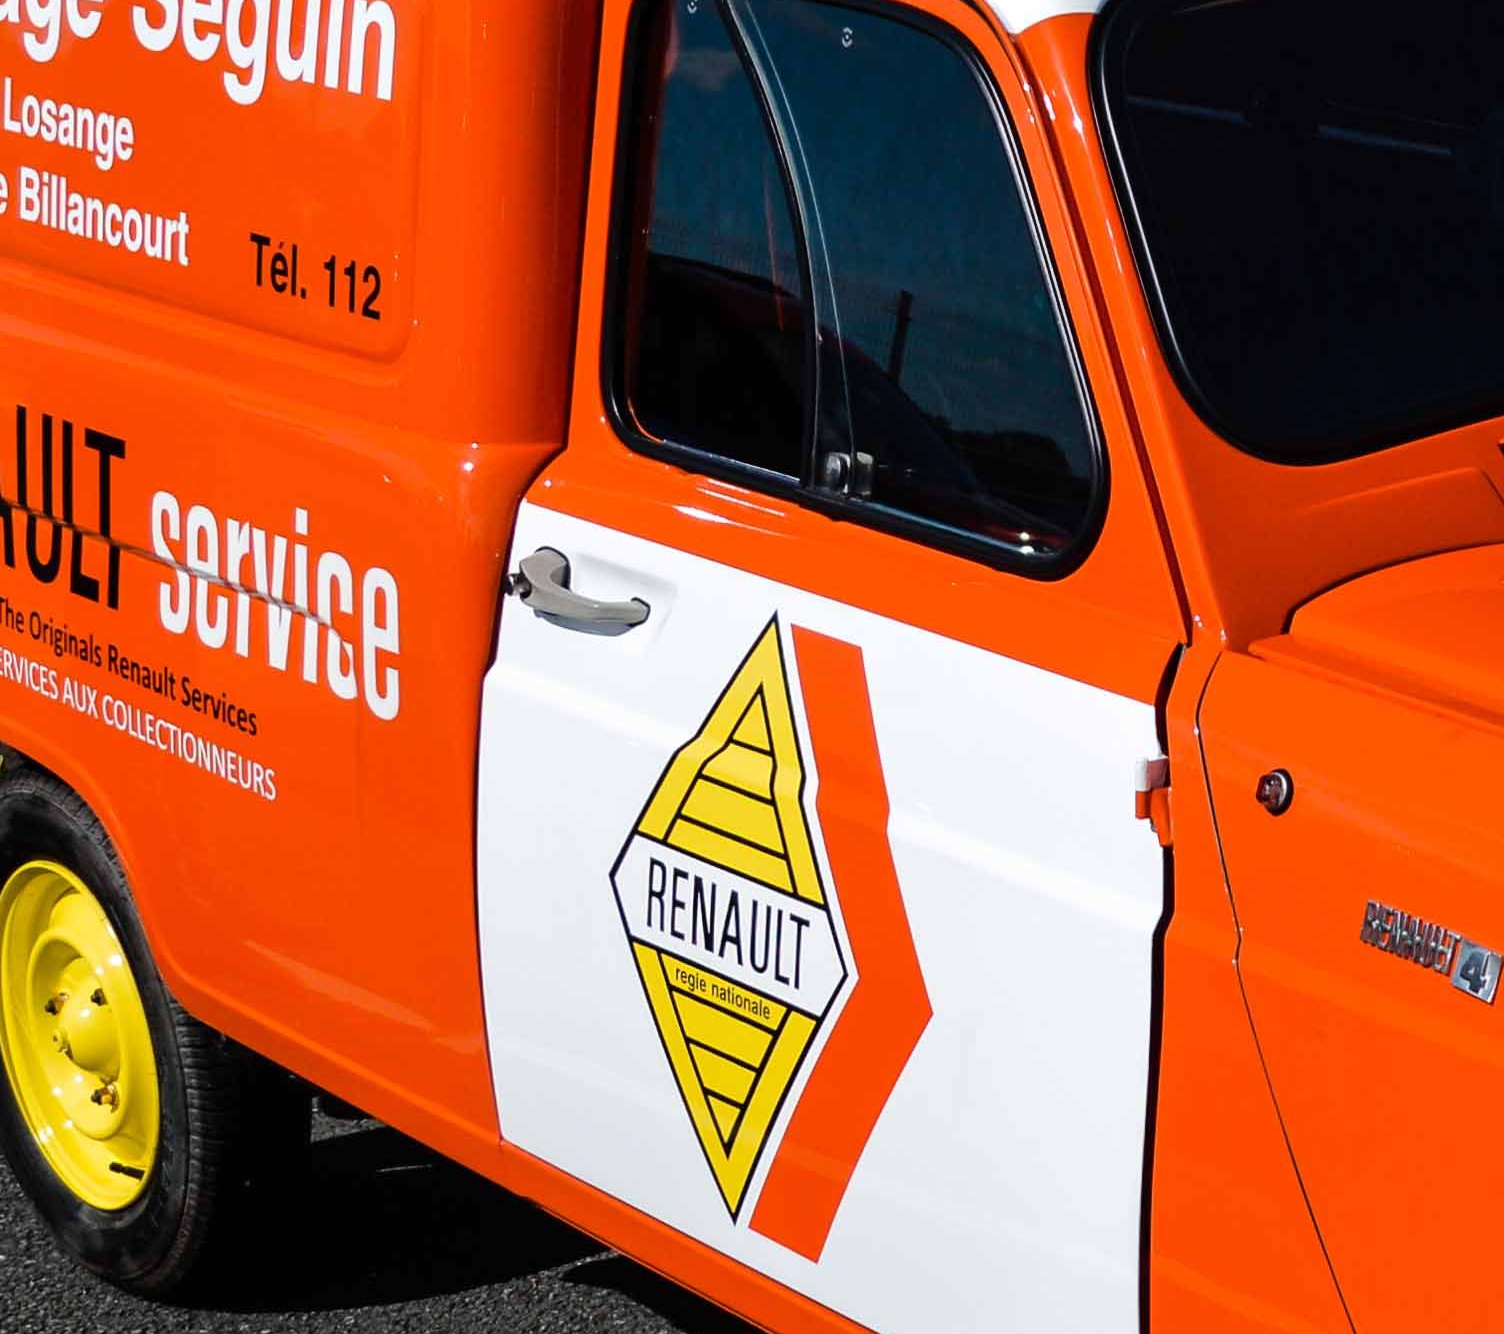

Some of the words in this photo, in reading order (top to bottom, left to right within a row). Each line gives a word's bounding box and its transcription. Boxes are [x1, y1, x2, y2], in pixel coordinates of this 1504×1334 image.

[4, 78, 134, 170] Losange
[19, 167, 189, 265] Billancourt
[250, 233, 307, 299] Tél.
[323, 255, 381, 320] 112
[151, 491, 400, 720] service
[29, 612, 102, 668] Originals
[107, 643, 176, 695] Renault
[181, 677, 258, 736] Services
[62, 677, 98, 719] AUX
[102, 695, 276, 801] COLLECTIONNEURS
[646, 857, 811, 990] RENAULT
[1359, 898, 1463, 976] RENAULT
[675, 967, 707, 992] regie
[711, 983, 771, 1020] nationale
